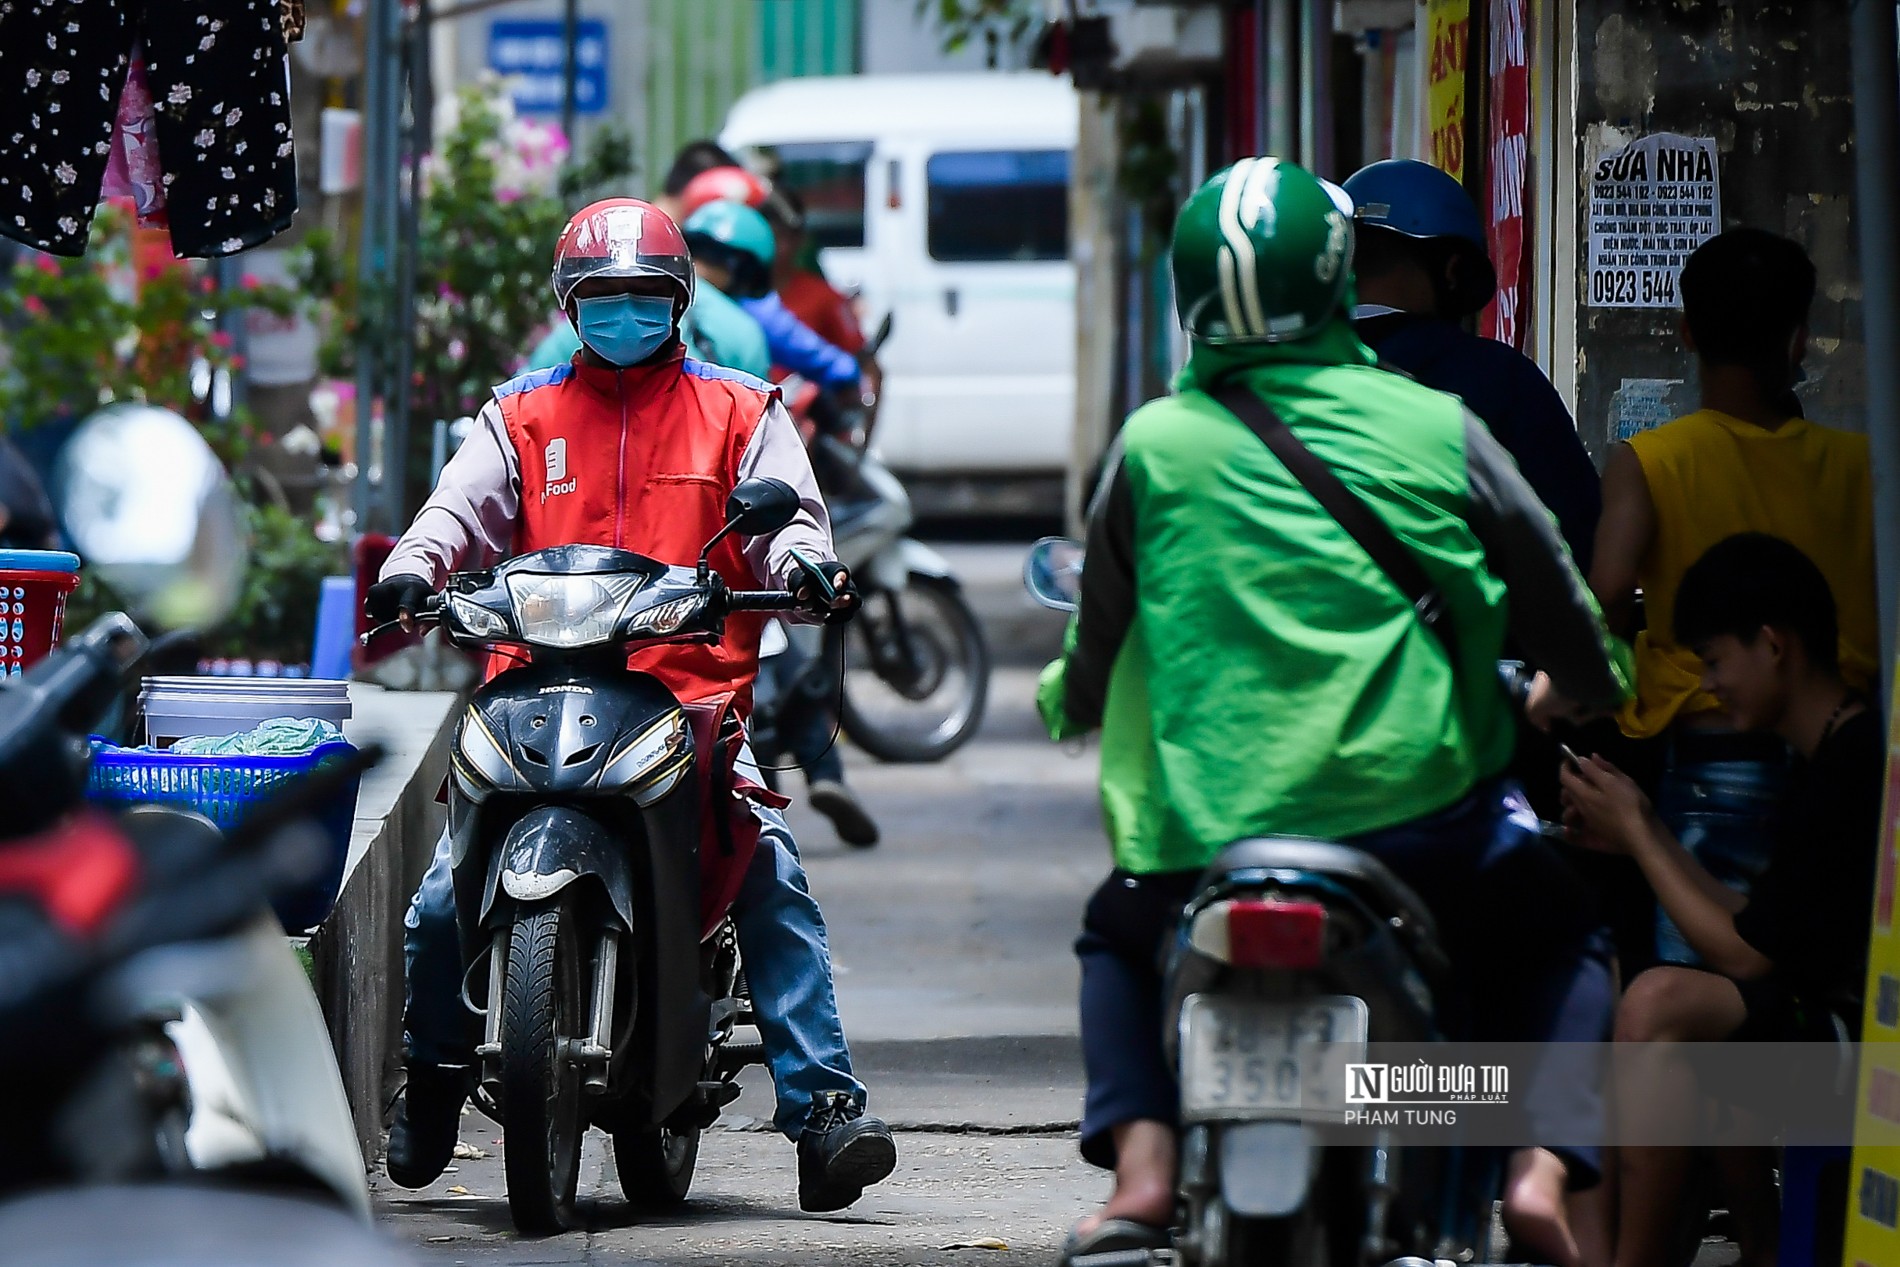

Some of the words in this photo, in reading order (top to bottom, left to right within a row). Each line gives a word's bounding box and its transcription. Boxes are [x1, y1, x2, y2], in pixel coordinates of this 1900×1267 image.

[1657, 145, 1714, 181] NHÀ
[1594, 185, 1614, 200] 0923
[1616, 185, 1632, 200] 544
[1657, 185, 1677, 200] 0923
[1679, 185, 1695, 200] 544
[1594, 270, 1637, 303] 0923
[1642, 270, 1675, 303] 544
[538, 684, 594, 695] HONDA
